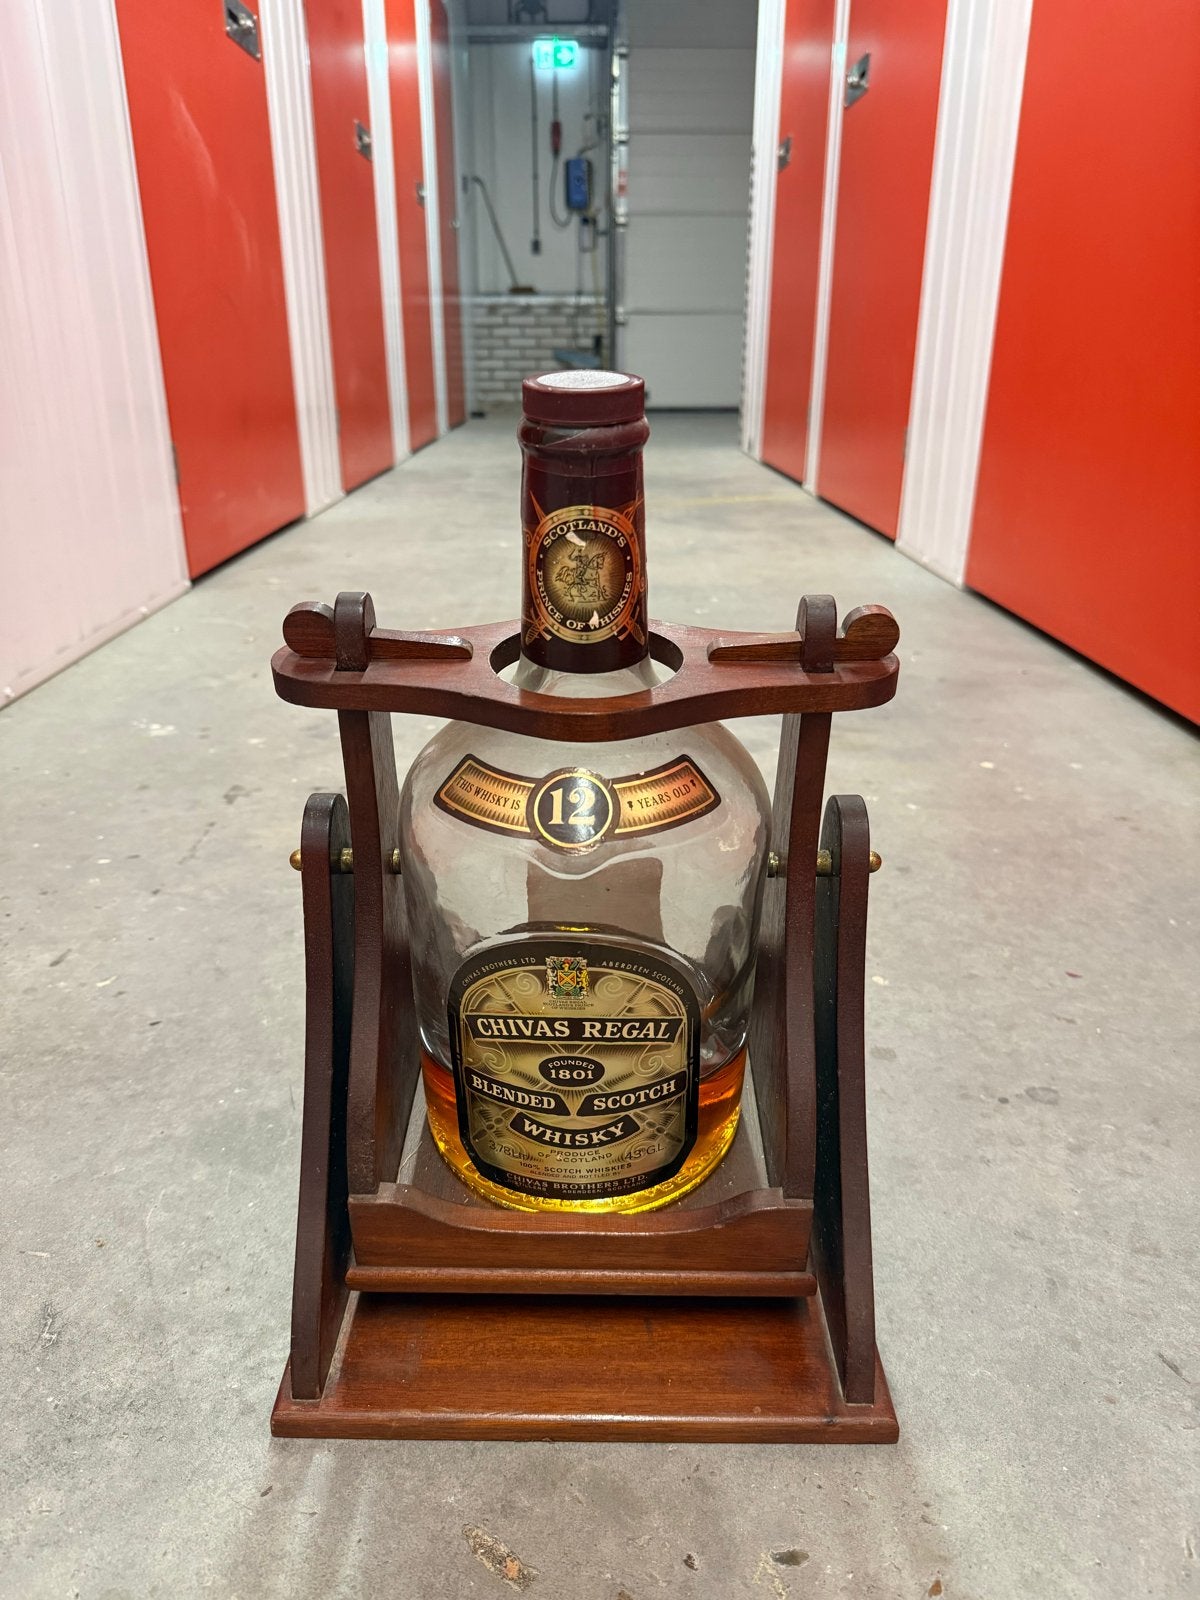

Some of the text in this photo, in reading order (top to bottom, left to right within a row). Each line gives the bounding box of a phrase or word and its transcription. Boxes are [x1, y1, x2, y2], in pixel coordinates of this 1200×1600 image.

[543, 520, 627, 548] SCOTLAND'S
[536, 569, 633, 631] PRINCE OF WHISKIES
[456, 776, 691, 825] THIS WHISKY IS 12 YEARS OLD
[462, 969, 480, 987] CHIVAS
[481, 958, 518, 973] BROTHERS
[601, 961, 684, 995] ABERDEEN SCOTLAND
[477, 1018, 671, 1039] CHIVAS REGAL
[548, 1060, 595, 1071] FOUNDED
[550, 1069, 594, 1080] 1801
[471, 1074, 676, 1111] BLENDED SCOTCH
[523, 1118, 625, 1147] WHISKY
[550, 1149, 601, 1158] PRODUCE
[556, 1152, 613, 1163] SCOTLAND
[519, 1161, 632, 1174] 100% SCOTCH WHISKIES
[506, 1173, 548, 1188] CHIVAS
[553, 1180, 619, 1190] BROTHERS
